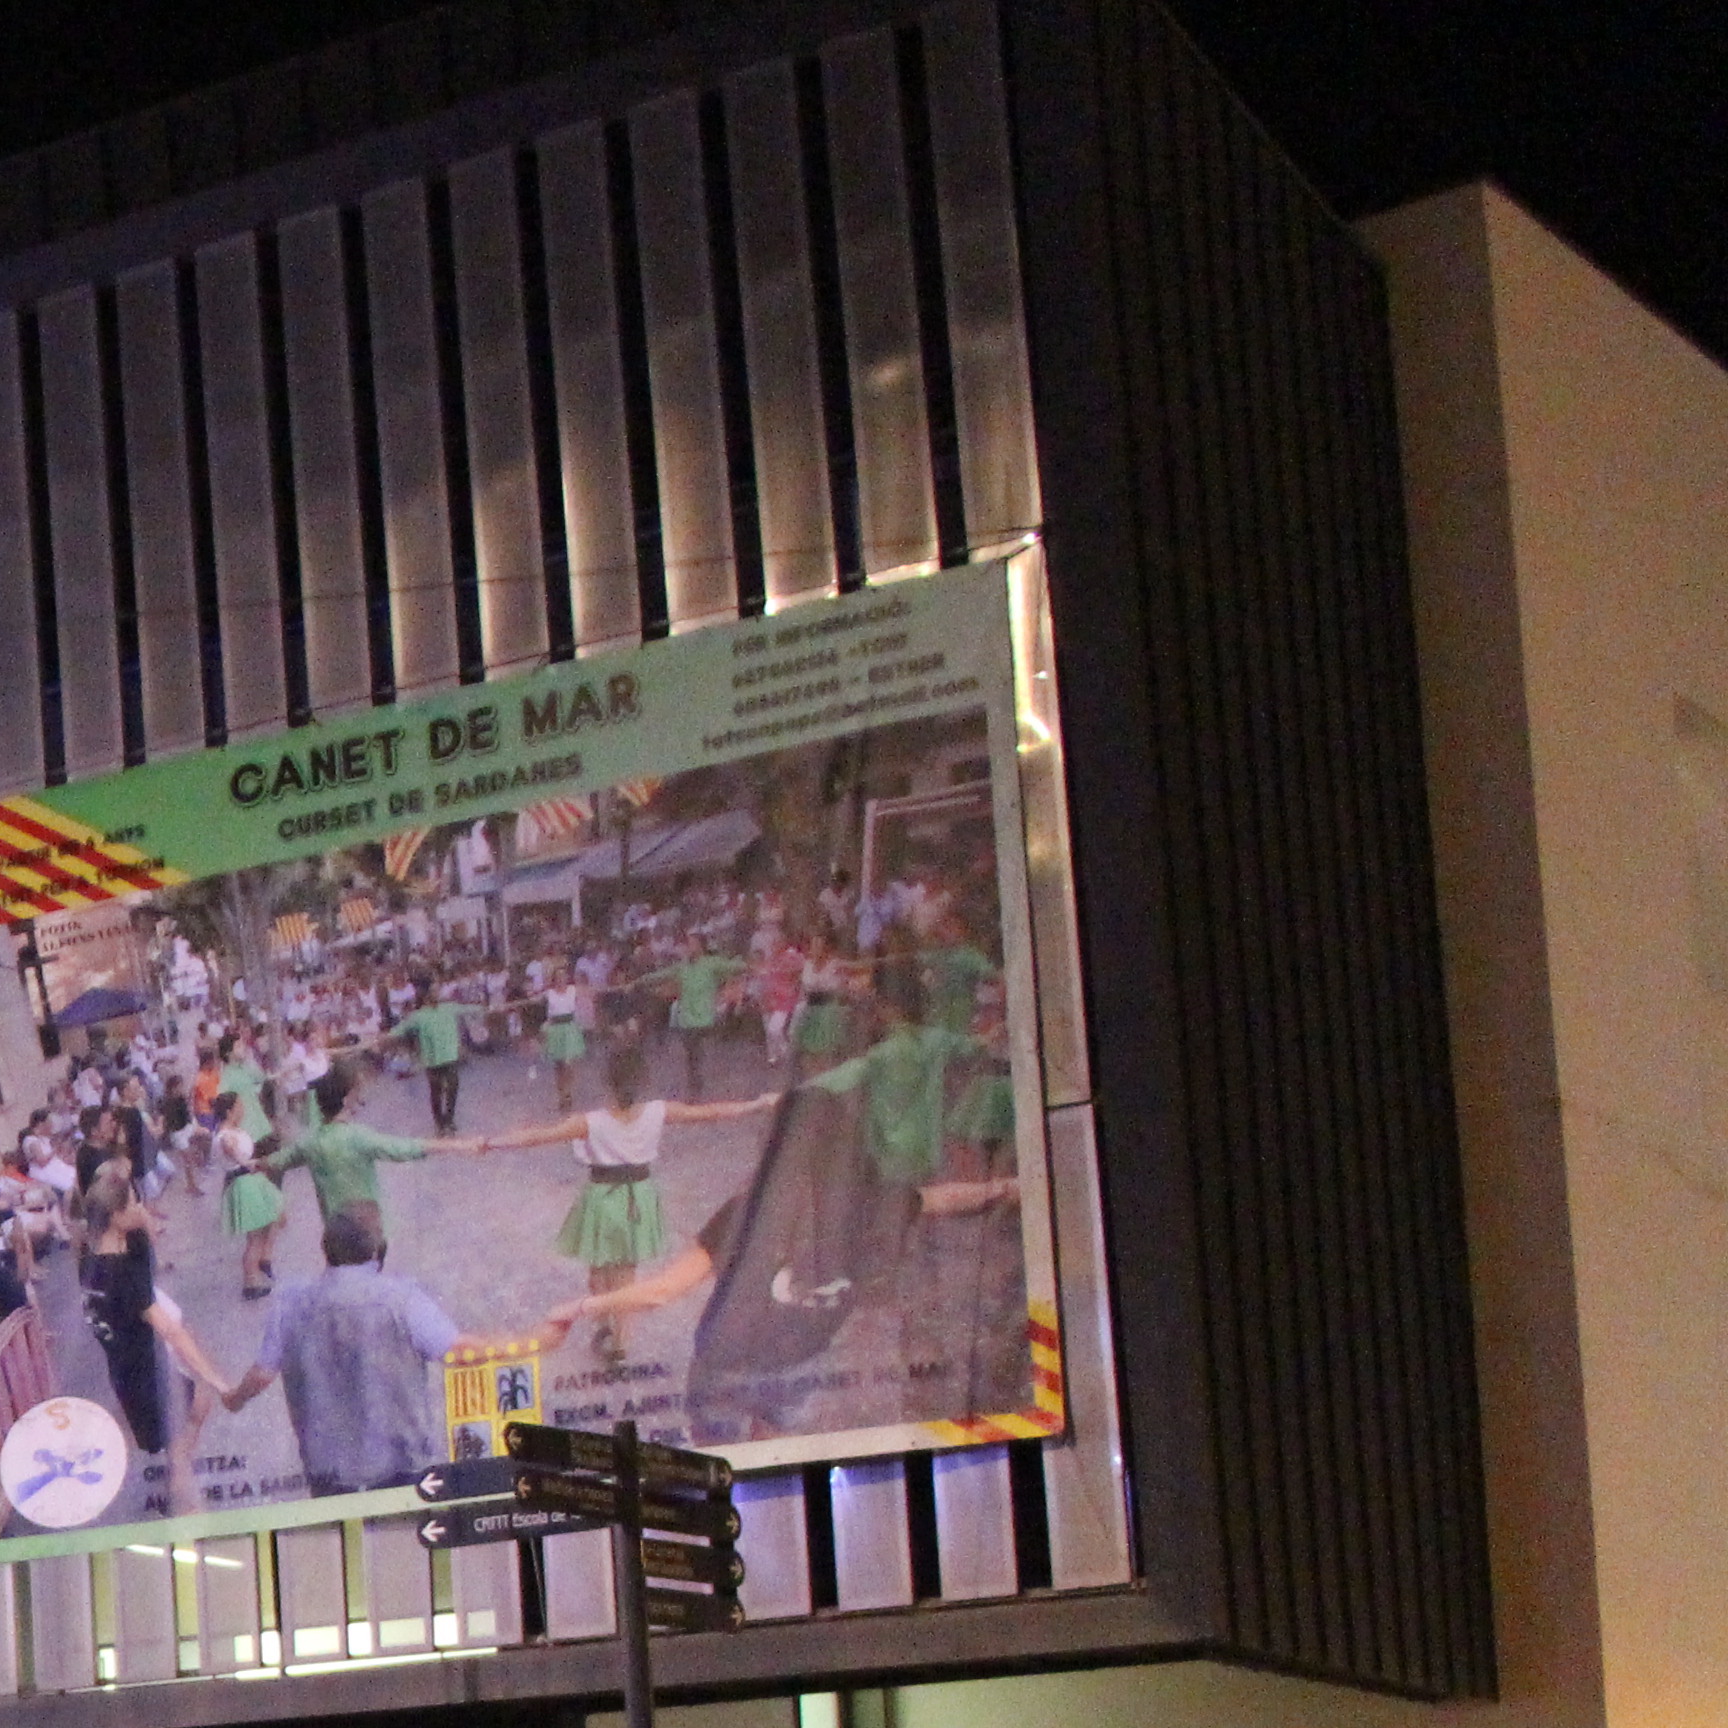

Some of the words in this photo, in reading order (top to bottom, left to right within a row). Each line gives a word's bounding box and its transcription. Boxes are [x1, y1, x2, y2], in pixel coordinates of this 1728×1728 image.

[229, 728, 405, 807] CANET
[428, 705, 500, 766] DE
[521, 671, 642, 748] MAR
[277, 798, 377, 841] CURSET
[387, 788, 425, 818] DE
[432, 751, 583, 810] SARDANES
[229, 1481, 254, 1499] LA
